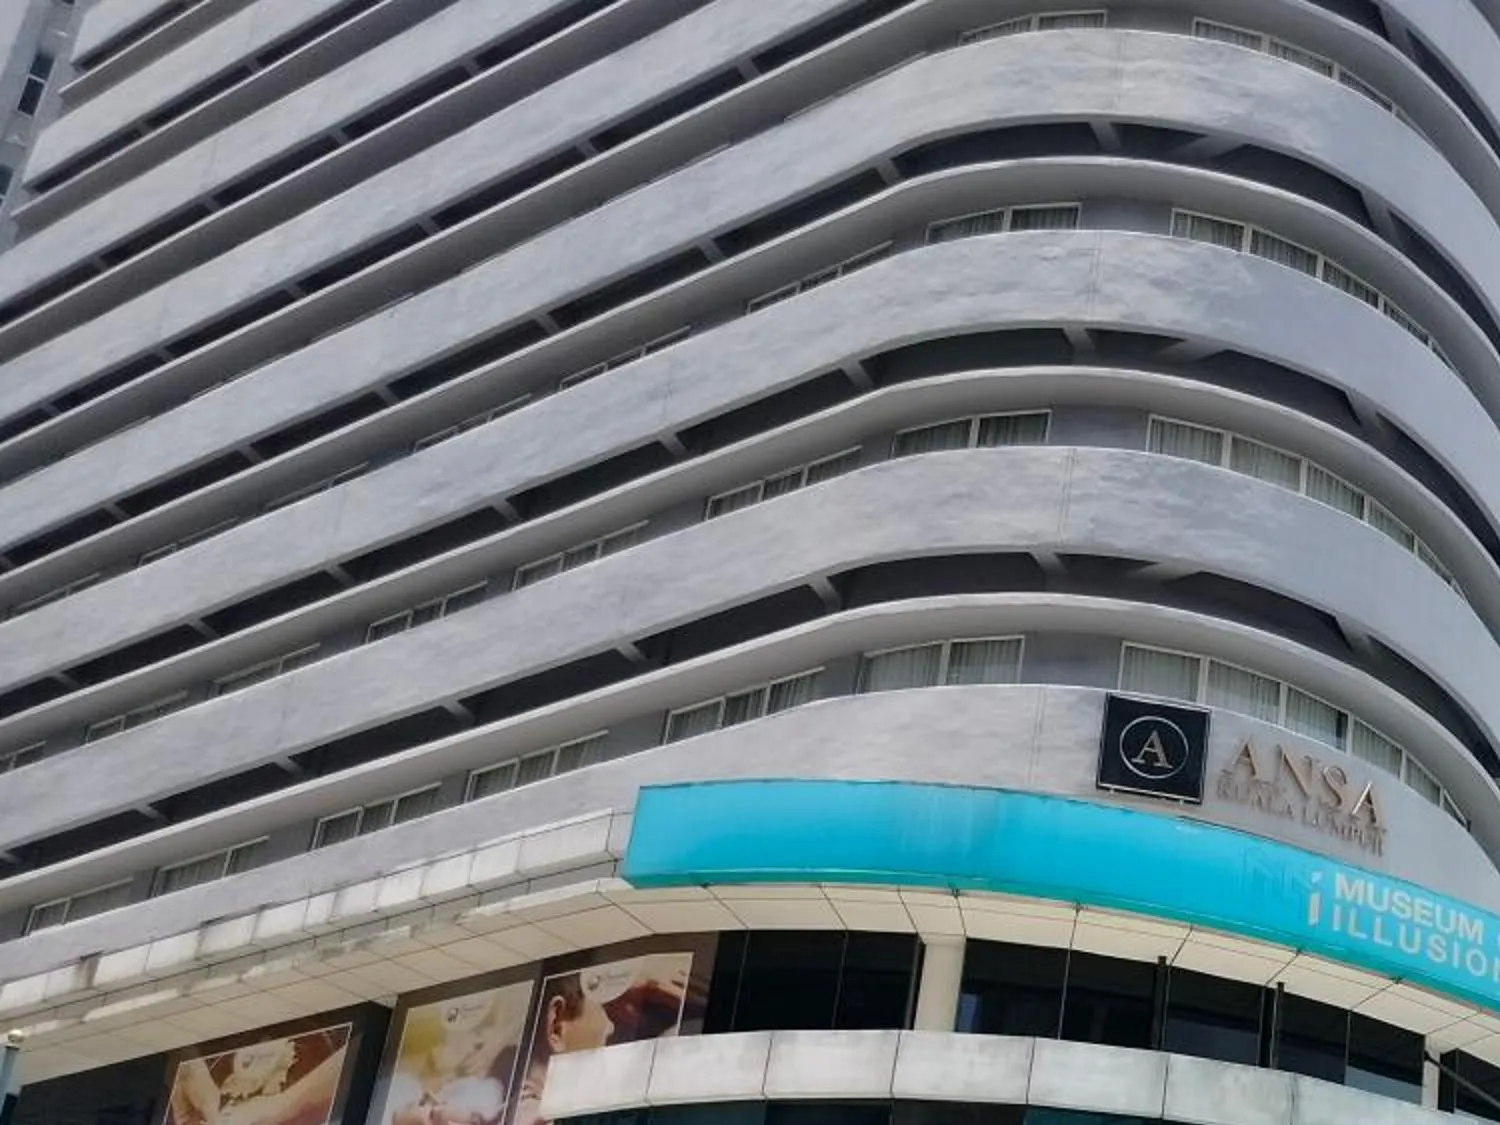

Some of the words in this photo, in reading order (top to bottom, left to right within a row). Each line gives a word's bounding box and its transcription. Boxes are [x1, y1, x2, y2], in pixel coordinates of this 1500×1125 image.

[1130, 729, 1174, 769] A
[1230, 735, 1379, 825] ANSA
[1334, 871, 1485, 945] MUSEUM
